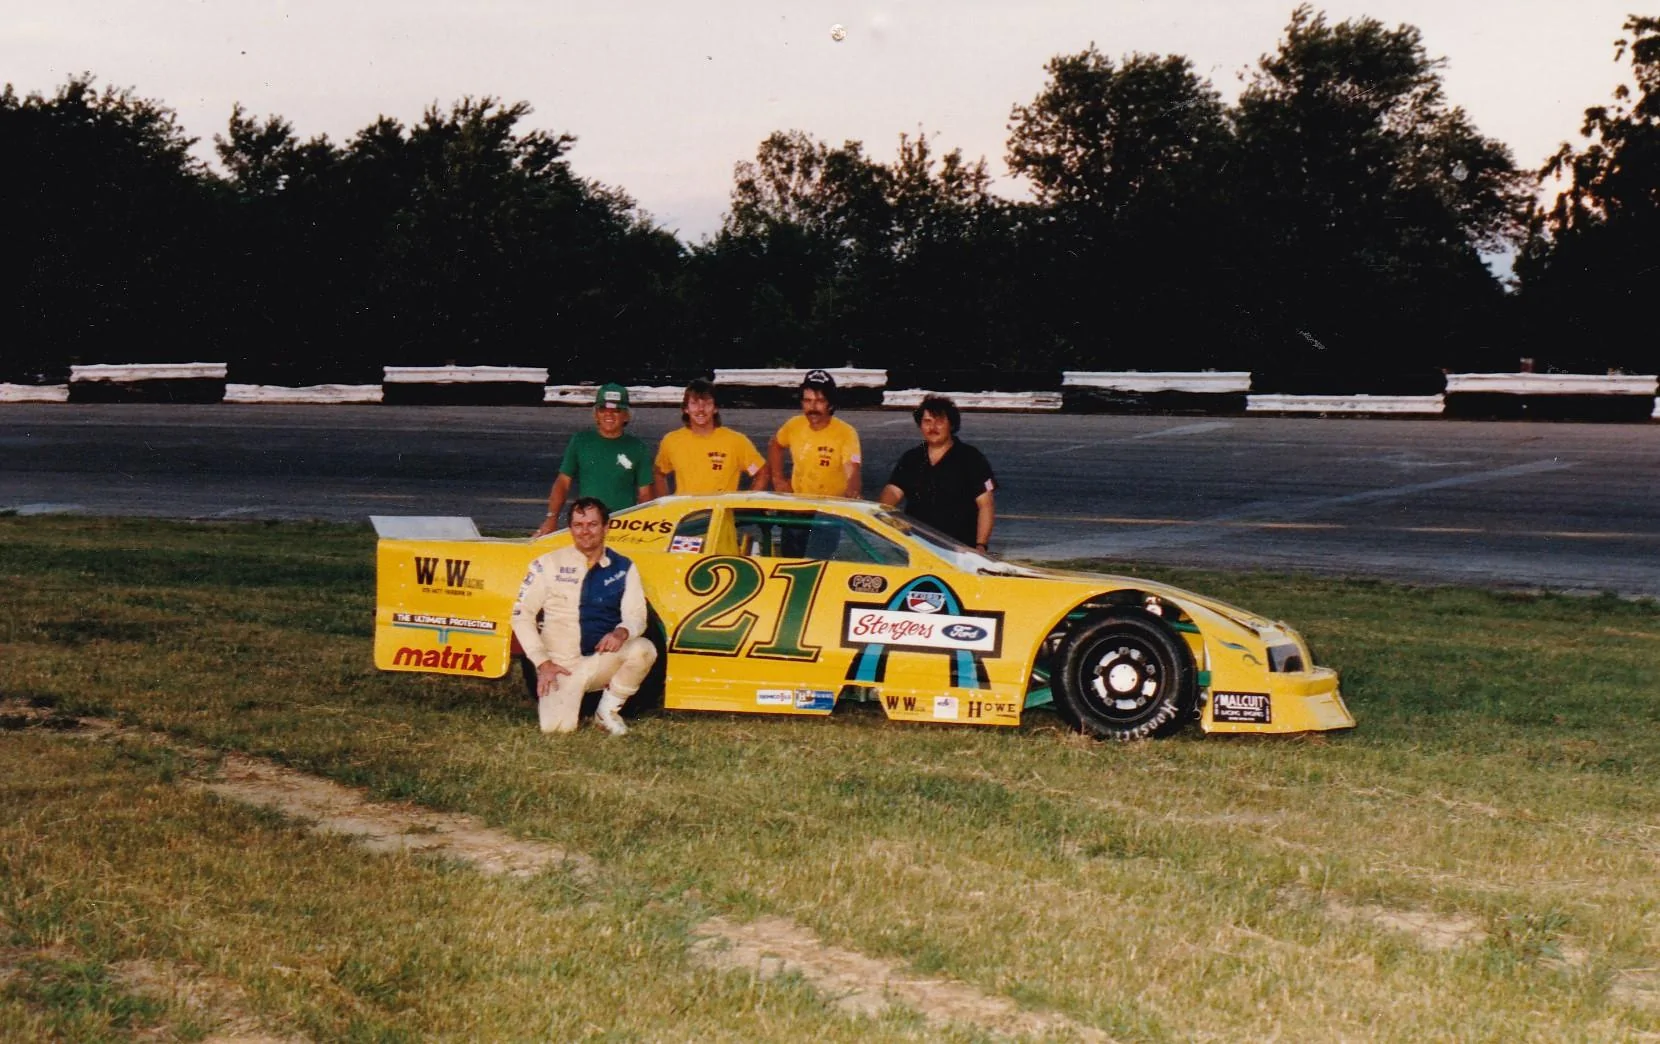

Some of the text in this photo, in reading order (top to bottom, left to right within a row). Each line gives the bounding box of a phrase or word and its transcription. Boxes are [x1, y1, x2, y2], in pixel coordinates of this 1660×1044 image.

[608, 519, 674, 534] DICK'S
[852, 575, 883, 589] PRO
[669, 555, 829, 663] 21
[397, 613, 495, 630] THE ULTIMATE PROTECTION
[853, 613, 979, 641] Stengers Ford
[392, 646, 488, 673] matrix
[1219, 694, 1264, 708] MALCUIT
